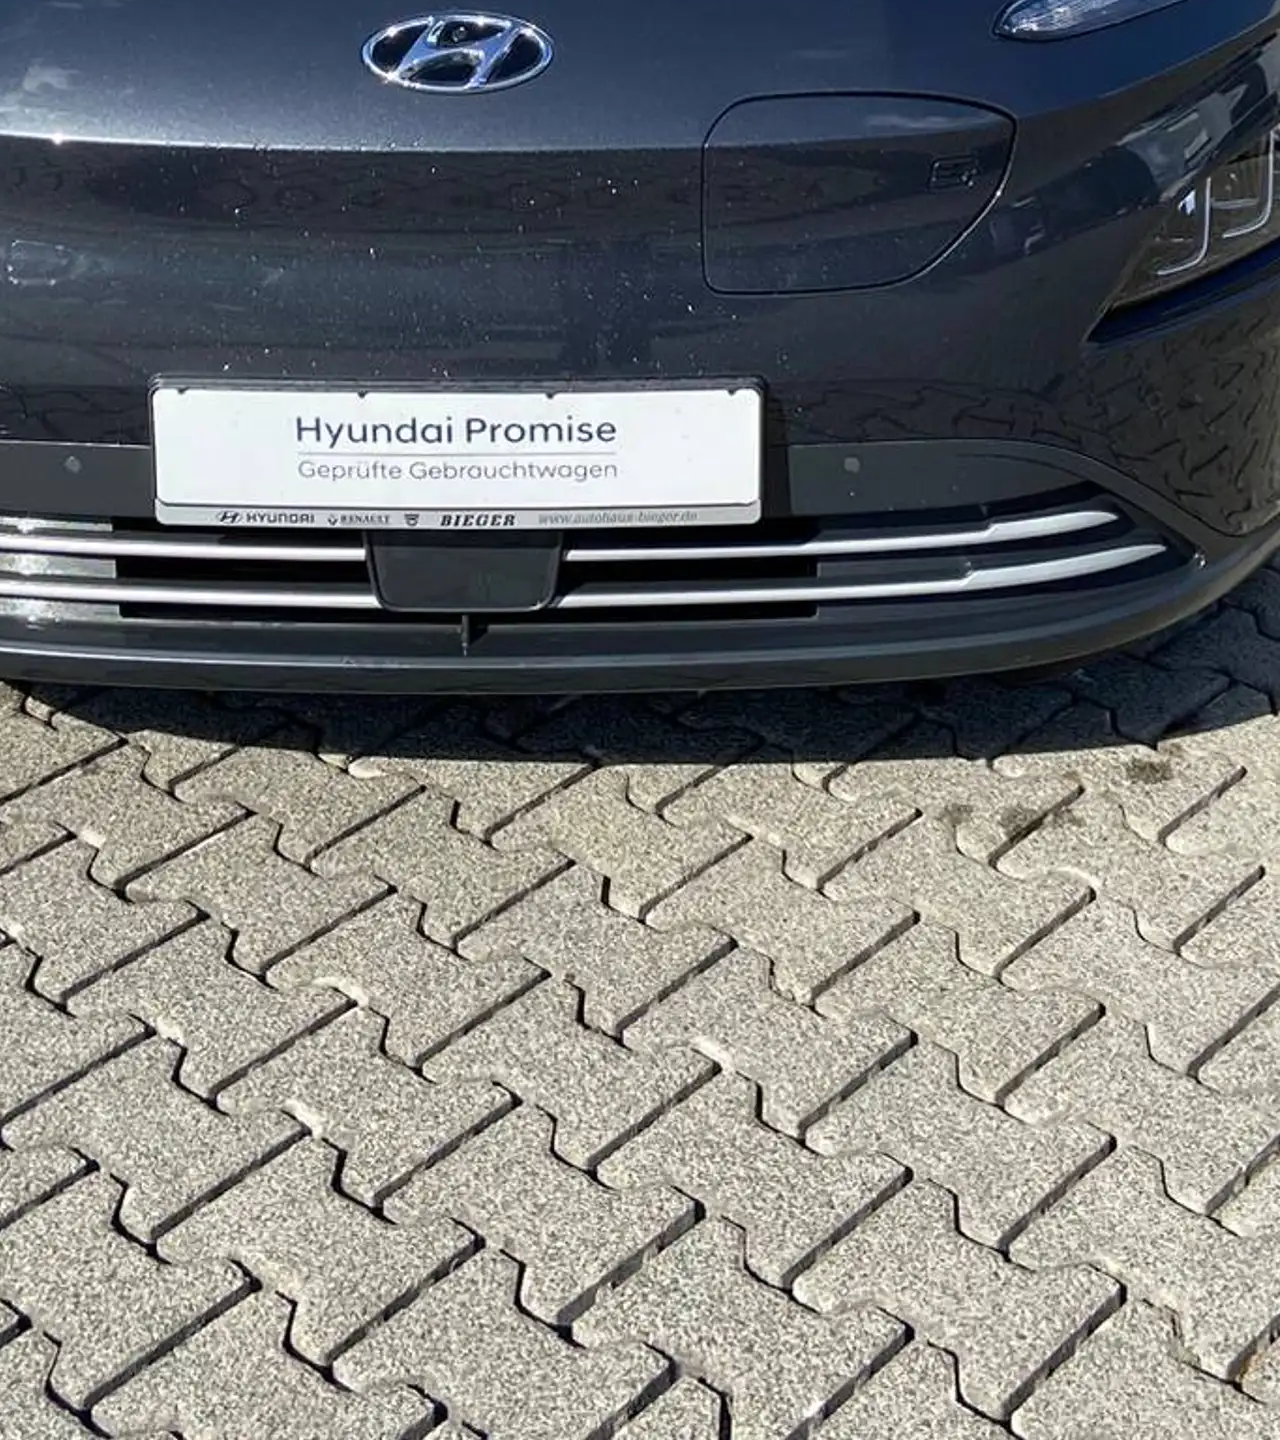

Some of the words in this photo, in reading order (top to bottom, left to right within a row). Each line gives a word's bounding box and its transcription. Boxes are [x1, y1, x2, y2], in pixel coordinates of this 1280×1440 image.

[296, 416, 453, 448] Hyundai
[466, 415, 617, 444] Promise
[298, 461, 402, 481] Geprüfte
[409, 461, 618, 482] Gebrauchtwagen
[246, 513, 315, 524] HYUNDAI
[440, 514, 517, 527] BIEGER
